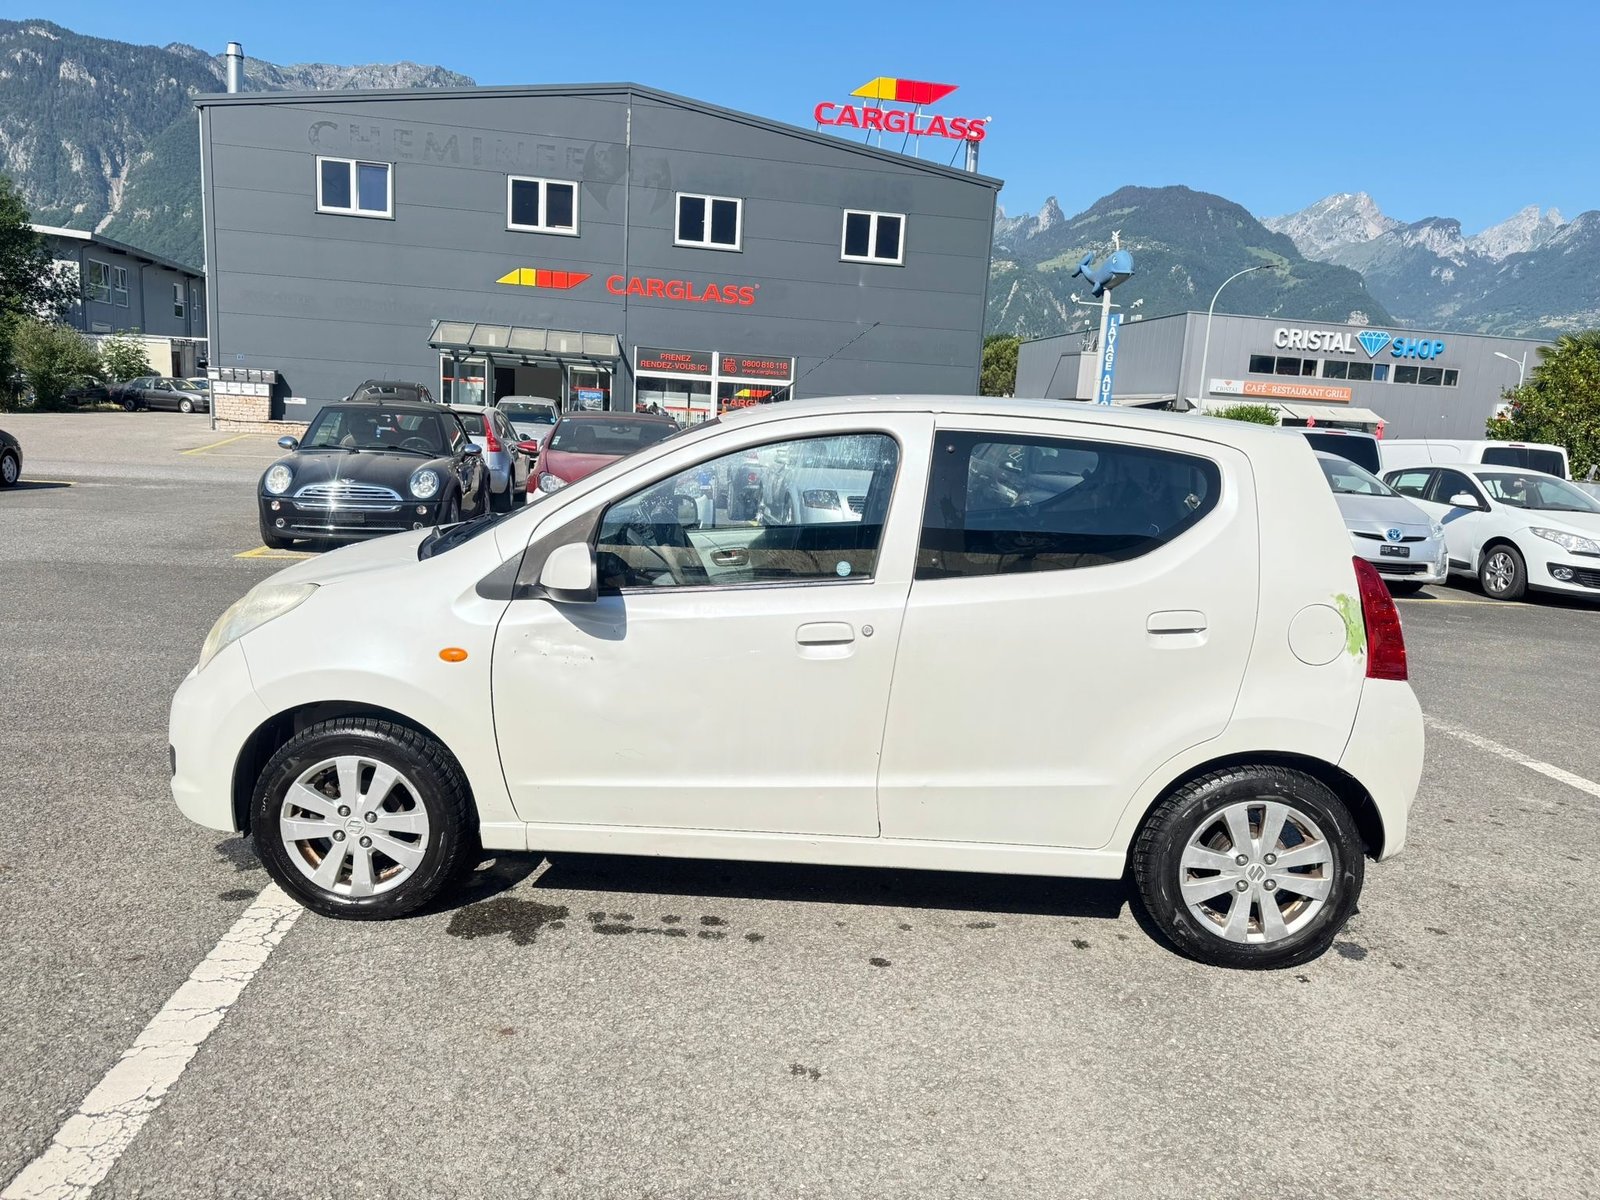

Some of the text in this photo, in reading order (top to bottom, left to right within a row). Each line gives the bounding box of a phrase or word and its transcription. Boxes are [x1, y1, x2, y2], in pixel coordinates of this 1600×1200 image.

[814, 102, 987, 142] CARGLASS
[1105, 317, 1117, 371] LAVAGE
[1274, 327, 1446, 360] CRISTAL SHOP
[660, 353, 691, 363] PRENEZ
[742, 359, 761, 368] 0800
[640, 359, 708, 372] RENDEZ-VOUS ICI
[1325, 389, 1349, 399] GRILL
